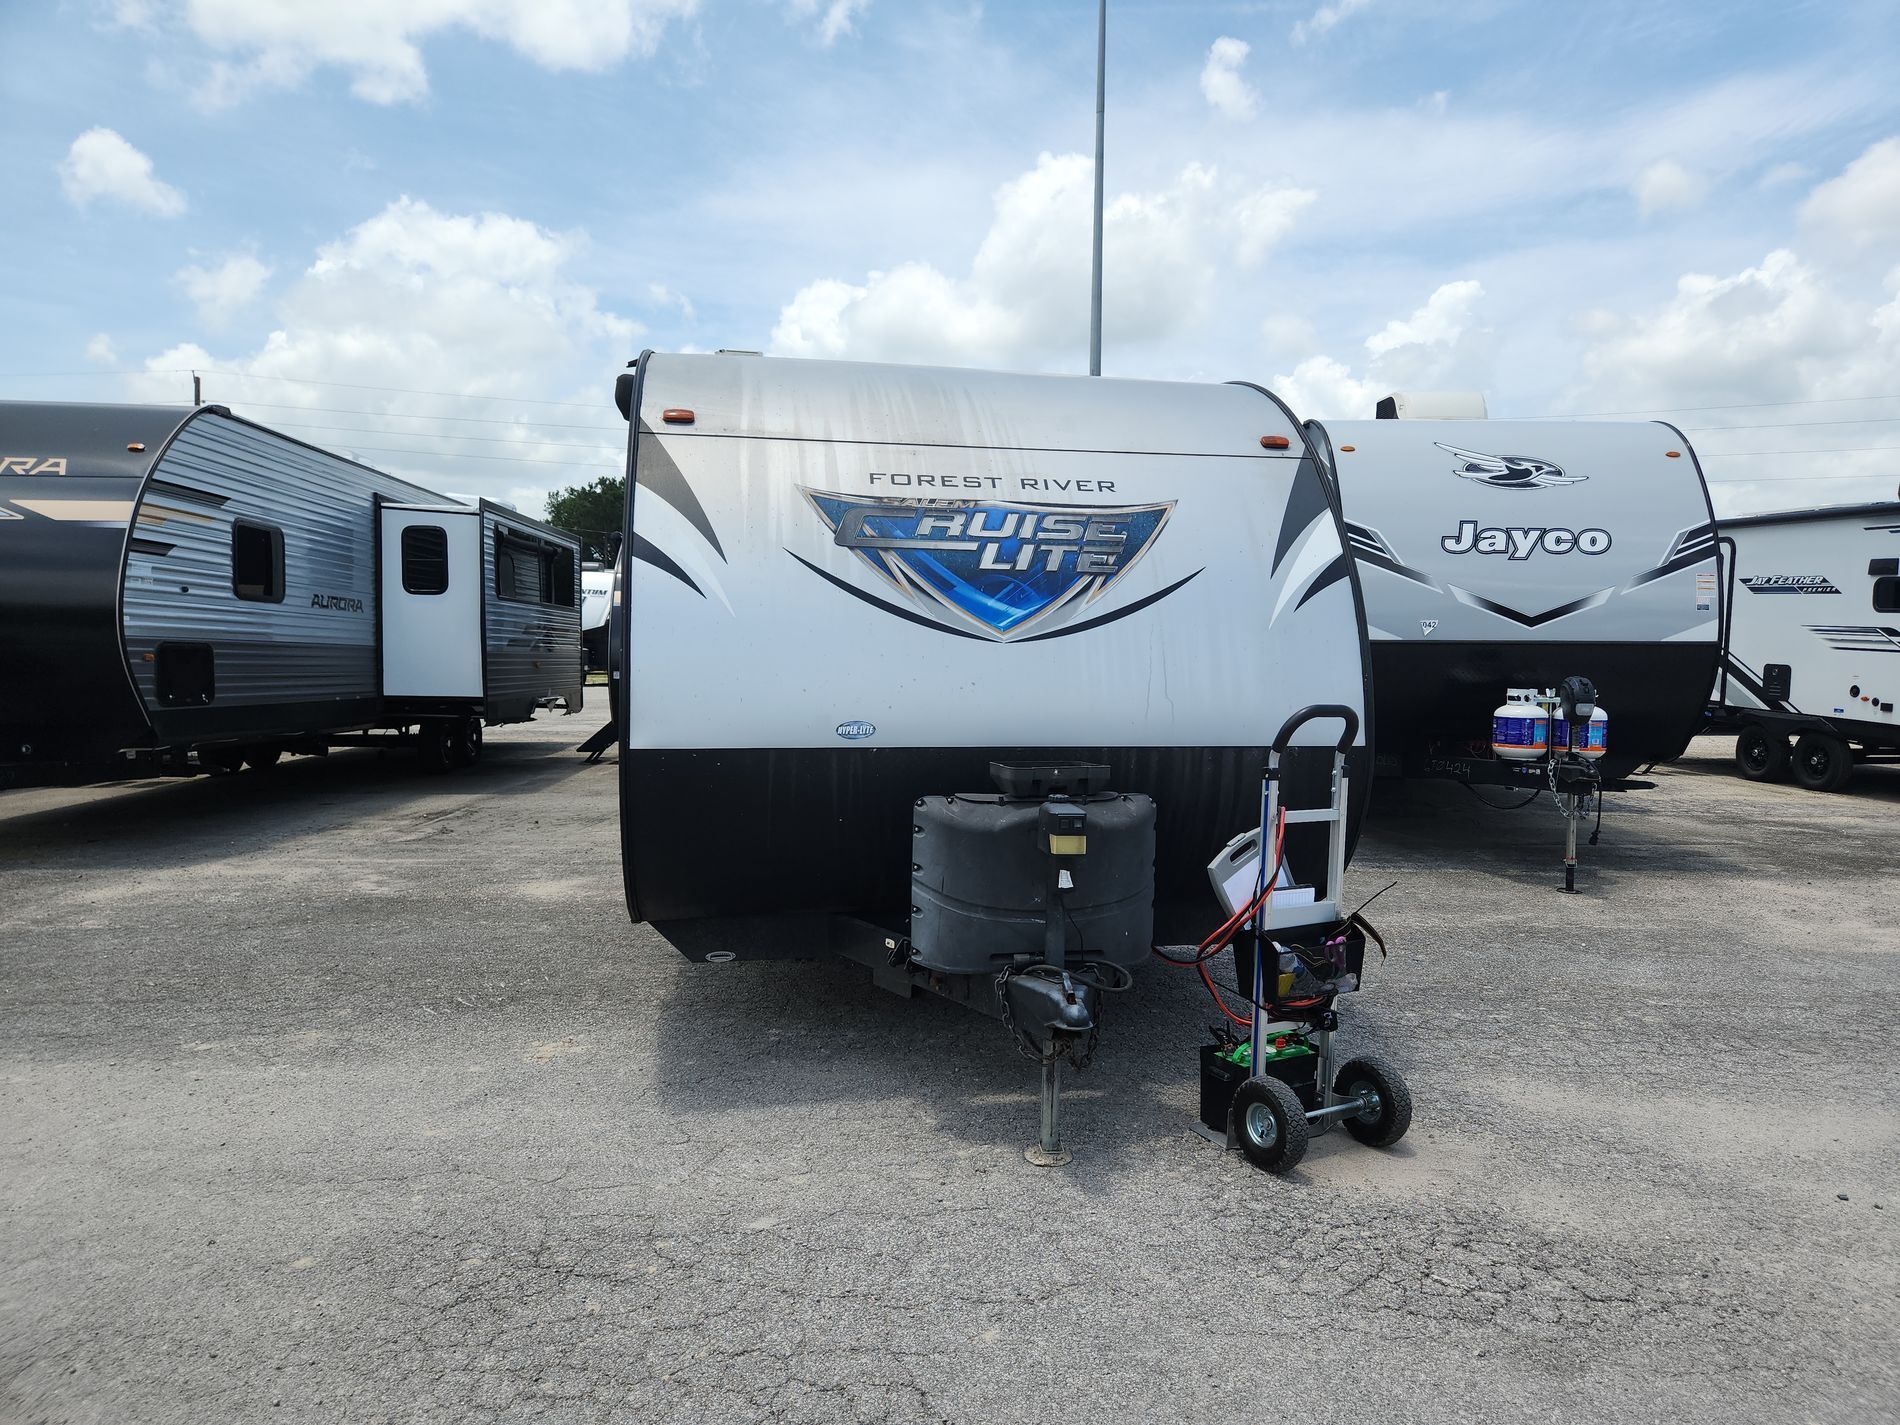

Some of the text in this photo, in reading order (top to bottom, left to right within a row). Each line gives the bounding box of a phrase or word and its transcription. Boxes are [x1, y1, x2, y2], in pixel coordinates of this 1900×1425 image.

[869, 472, 1117, 493] FOREST RIVER
[879, 497, 977, 510] SALEM
[833, 507, 1131, 551] CRUISE
[1440, 520, 1613, 561] Jayco
[978, 542, 1123, 573] LITE
[1745, 575, 1824, 586] JAY FEATHER
[311, 594, 364, 614] AURORA
[837, 725, 874, 735] HYPER-LYTE
